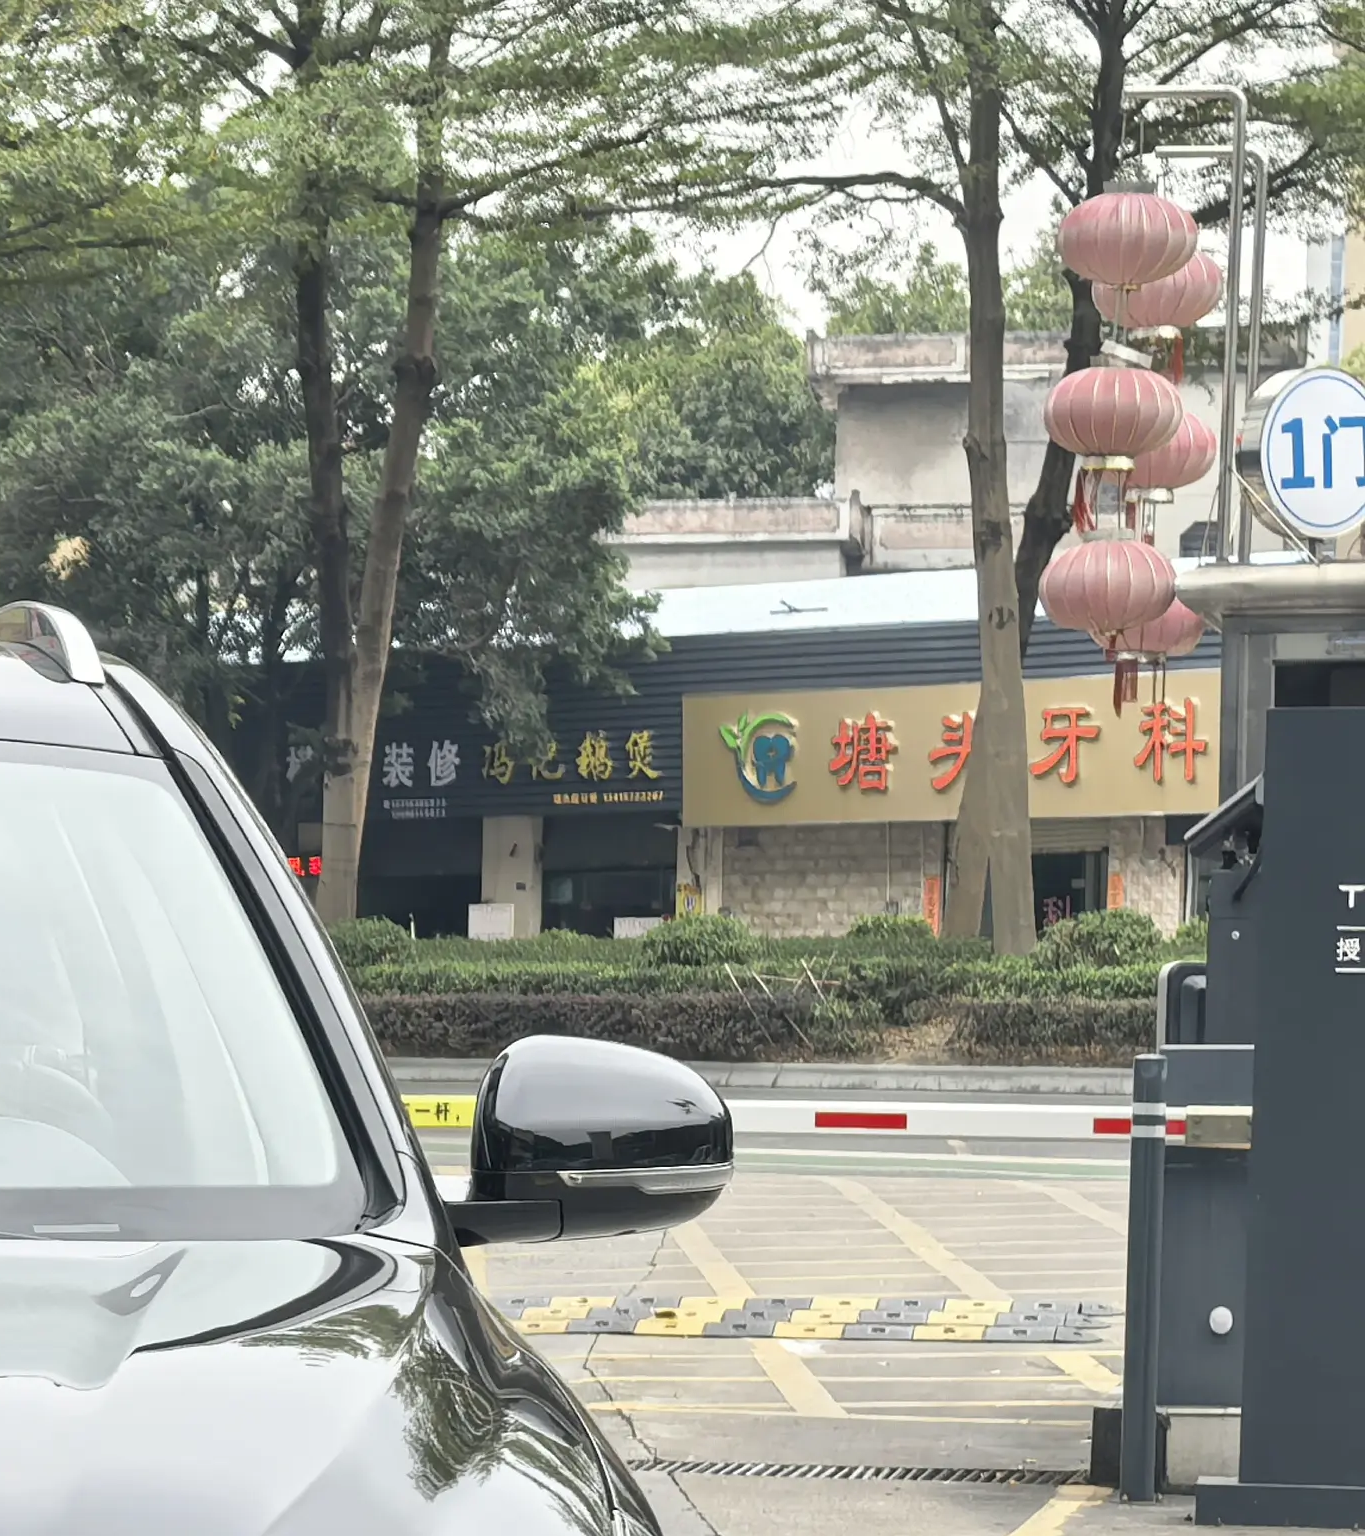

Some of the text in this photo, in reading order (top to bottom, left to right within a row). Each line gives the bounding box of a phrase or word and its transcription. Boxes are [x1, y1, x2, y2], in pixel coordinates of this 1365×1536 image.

[381, 739, 461, 788] 装修
[829, 697, 1207, 793] 塘头牙科
